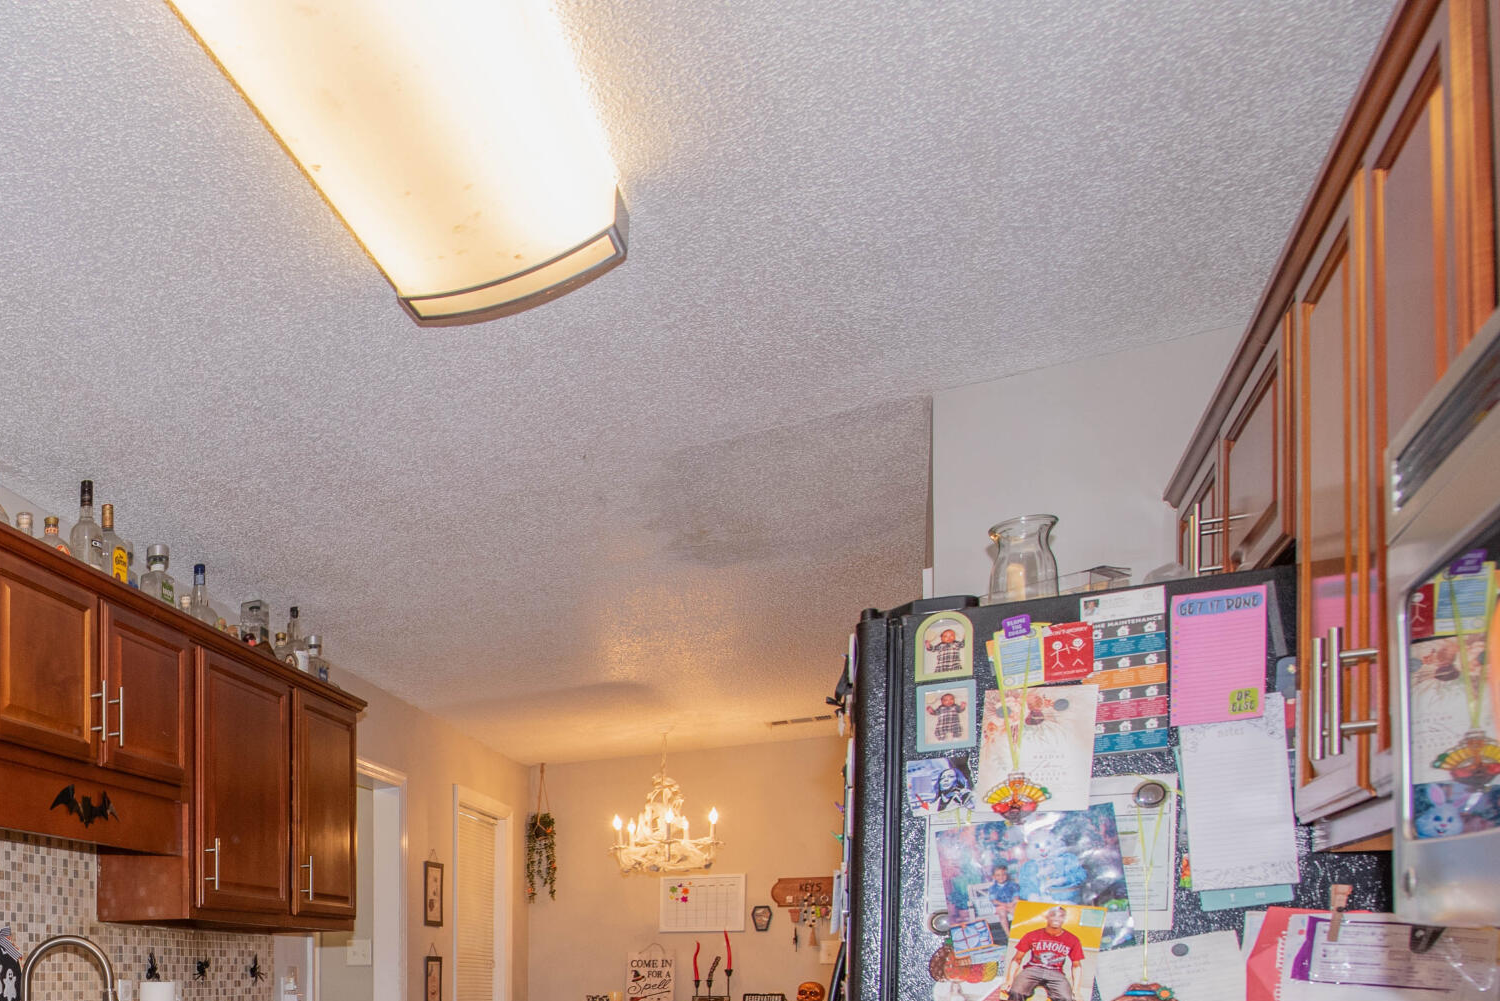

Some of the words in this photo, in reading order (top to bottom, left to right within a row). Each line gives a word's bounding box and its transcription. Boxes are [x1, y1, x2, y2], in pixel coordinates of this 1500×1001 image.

[1180, 601, 1203, 616] GET
[1210, 600, 1221, 613] IT
[1226, 594, 1259, 610] DONE
[1108, 615, 1163, 628] MAINTENANCE
[1237, 690, 1251, 701] OR
[1231, 700, 1255, 713] ELSE
[799, 883, 822, 892] KEYS
[1032, 940, 1071, 956] FAMOUS
[631, 959, 658, 968] COME
[661, 959, 673, 968] IN
[647, 970, 662, 978] FOR
[665, 970, 671, 978] A
[627, 979, 671, 995] Spell
